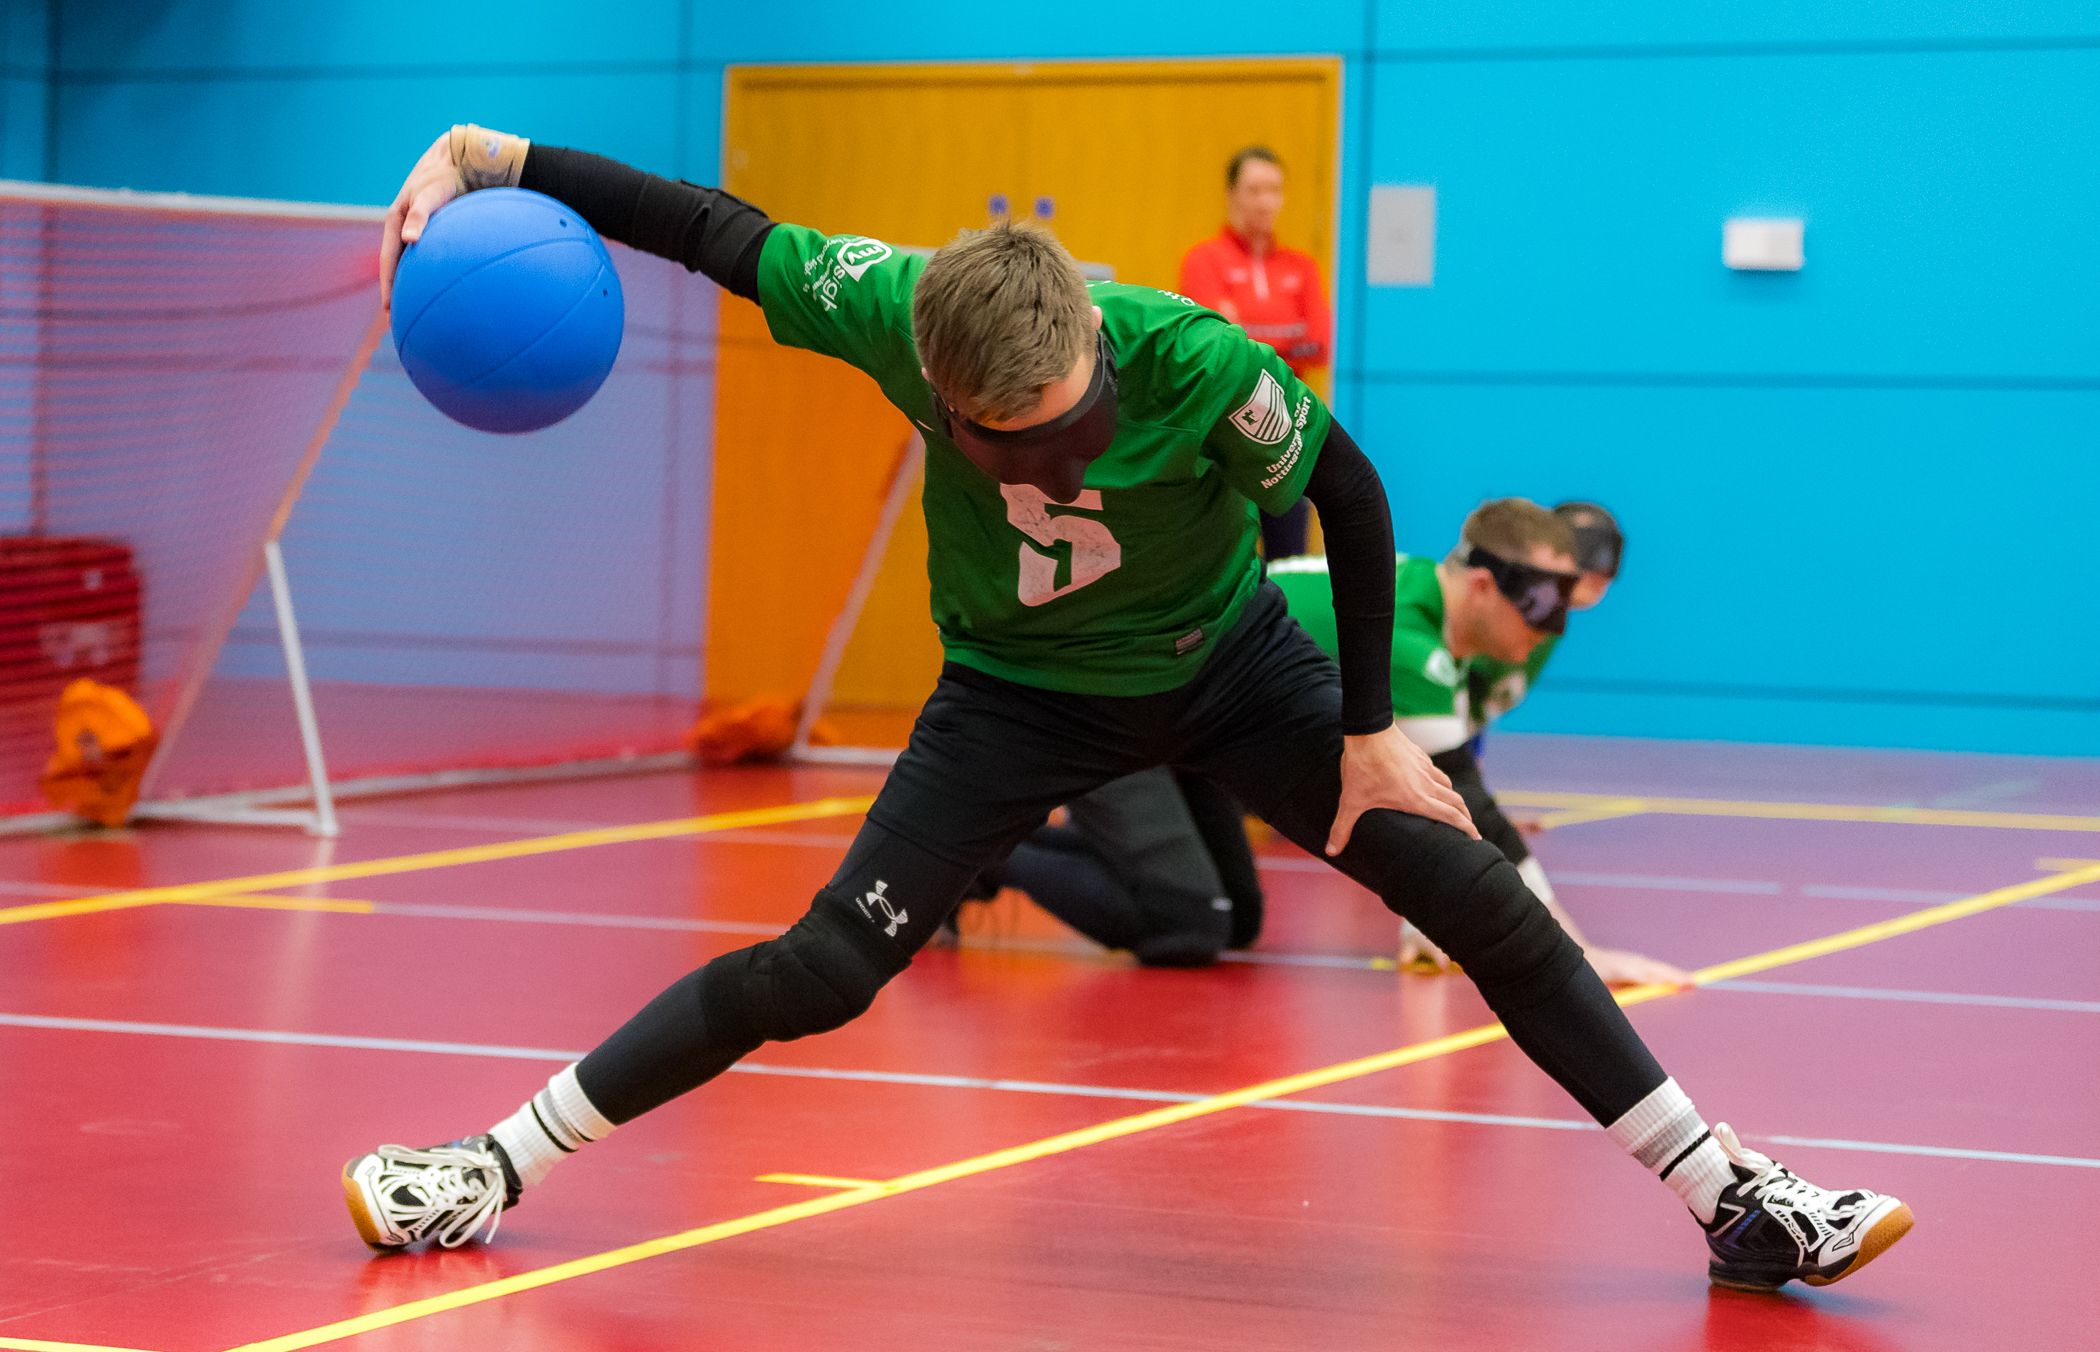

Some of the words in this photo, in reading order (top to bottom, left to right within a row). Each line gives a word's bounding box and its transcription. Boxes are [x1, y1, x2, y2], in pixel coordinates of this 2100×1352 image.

[820, 265, 846, 312] sigh
[1294, 396, 1311, 430] Sport
[1000, 482, 1121, 607] 5
